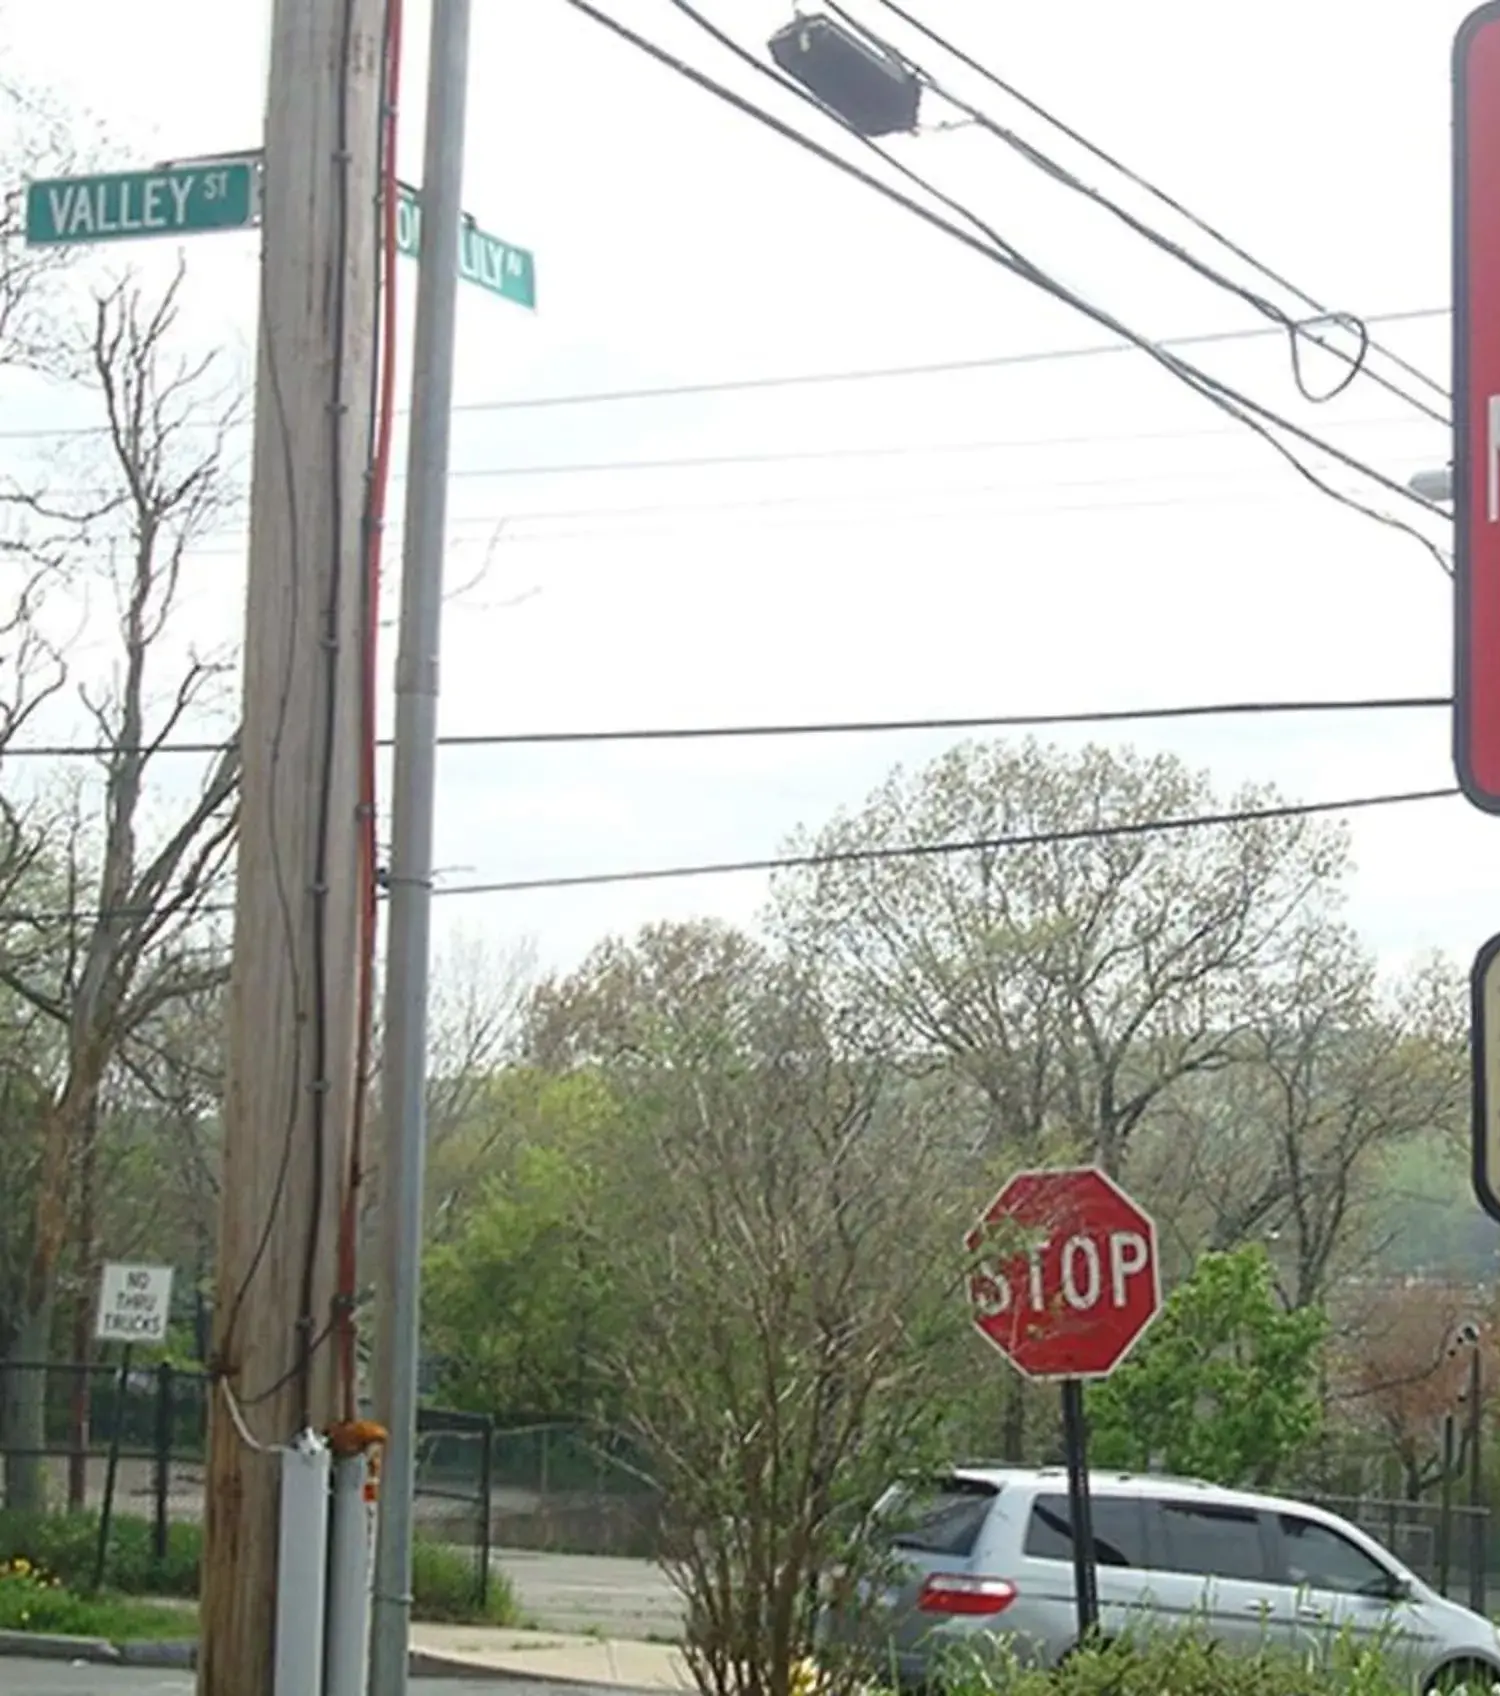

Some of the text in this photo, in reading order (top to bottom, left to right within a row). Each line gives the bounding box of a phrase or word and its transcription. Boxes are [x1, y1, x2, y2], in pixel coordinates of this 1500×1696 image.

[49, 171, 229, 236] VALLEY ST
[127, 1271, 152, 1290] NO
[972, 1231, 1148, 1316] STOP
[116, 1290, 159, 1312] THRU
[104, 1313, 161, 1335] TRUCKS
